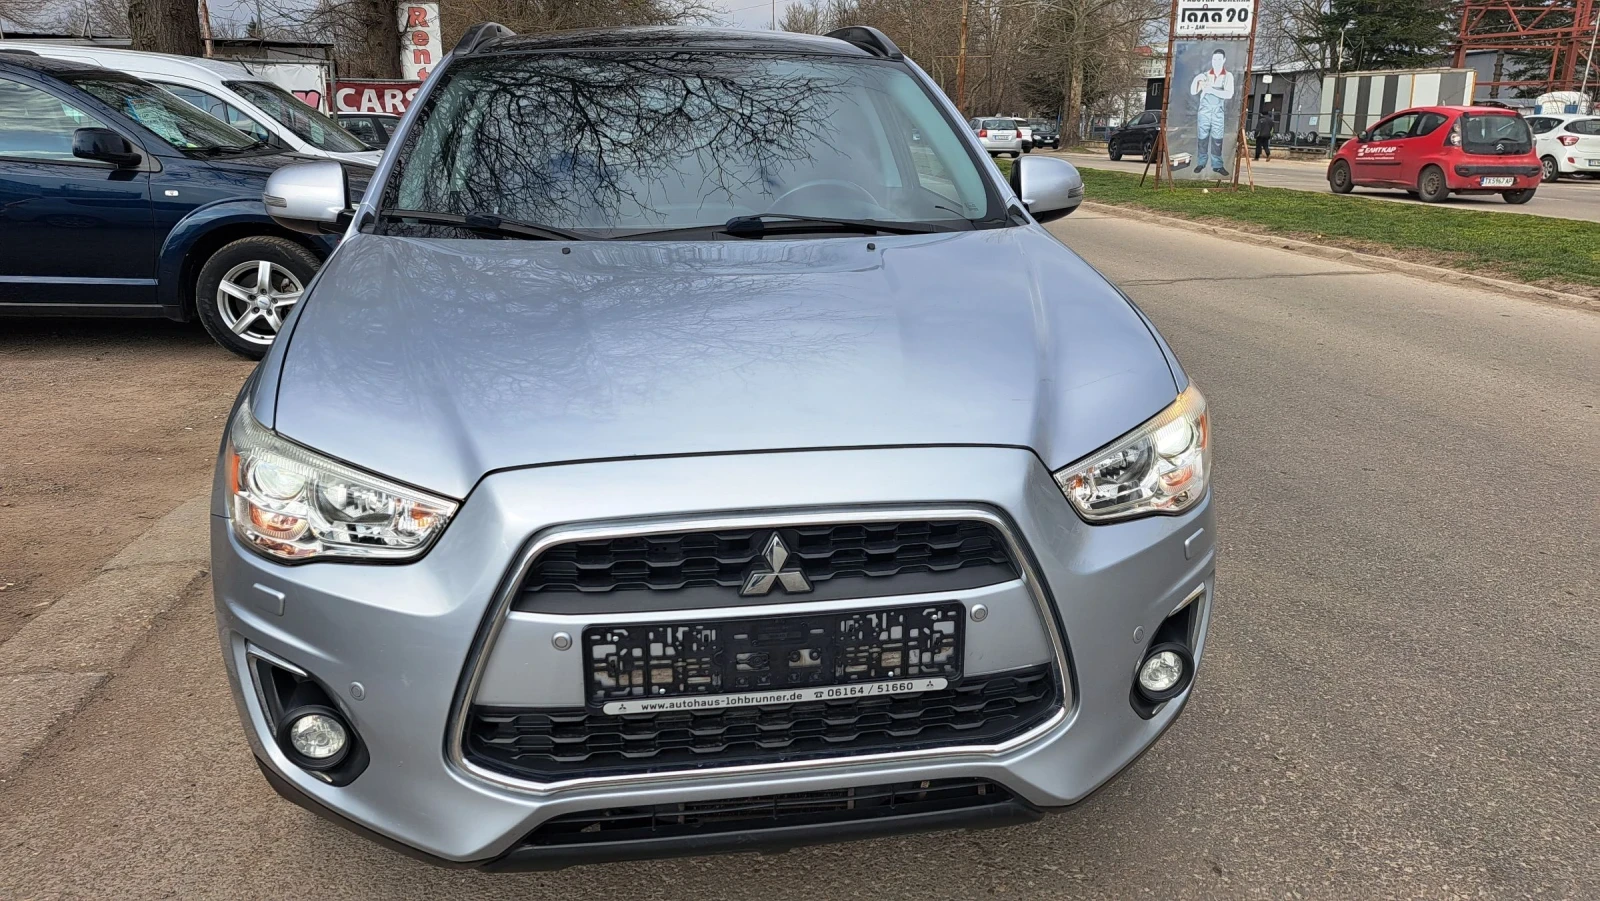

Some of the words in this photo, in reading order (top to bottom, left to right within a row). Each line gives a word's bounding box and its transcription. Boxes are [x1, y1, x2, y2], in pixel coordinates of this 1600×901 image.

[1181, 8, 1224, 22] Гала
[1226, 8, 1249, 22] 90
[641, 692, 803, 711] www.autohaus-lohbrunner.de
[827, 687, 864, 698] 06164
[877, 682, 914, 693] 51660
